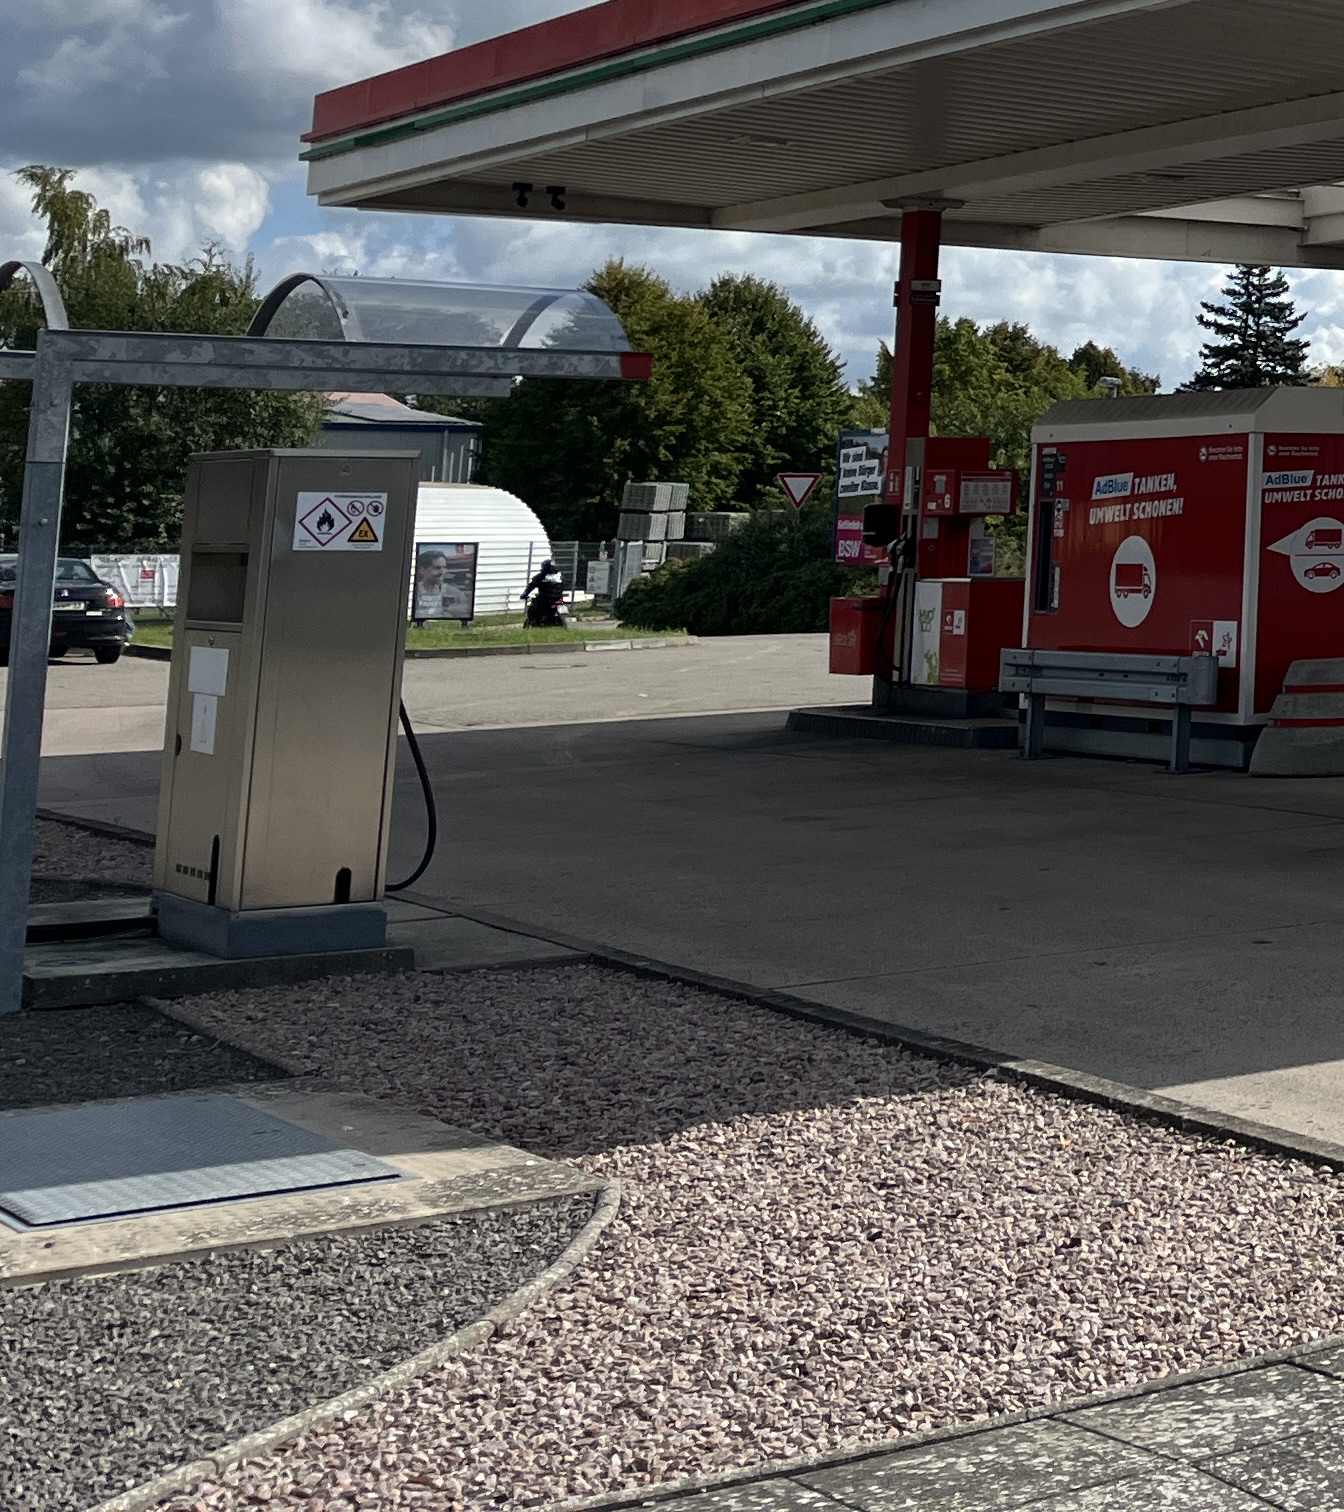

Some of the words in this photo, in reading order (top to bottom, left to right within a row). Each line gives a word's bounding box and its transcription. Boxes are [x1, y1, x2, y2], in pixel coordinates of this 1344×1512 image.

[1094, 478, 1130, 495] AdBlue
[1133, 472, 1177, 494] TANKEN,
[944, 493, 951, 509] 6
[1264, 489, 1312, 503] UMWELT
[1089, 506, 1132, 526] UMWELT
[1132, 496, 1185, 521] SCHONEN!
[359, 529, 369, 538] EX
[838, 539, 862, 558] BSW
